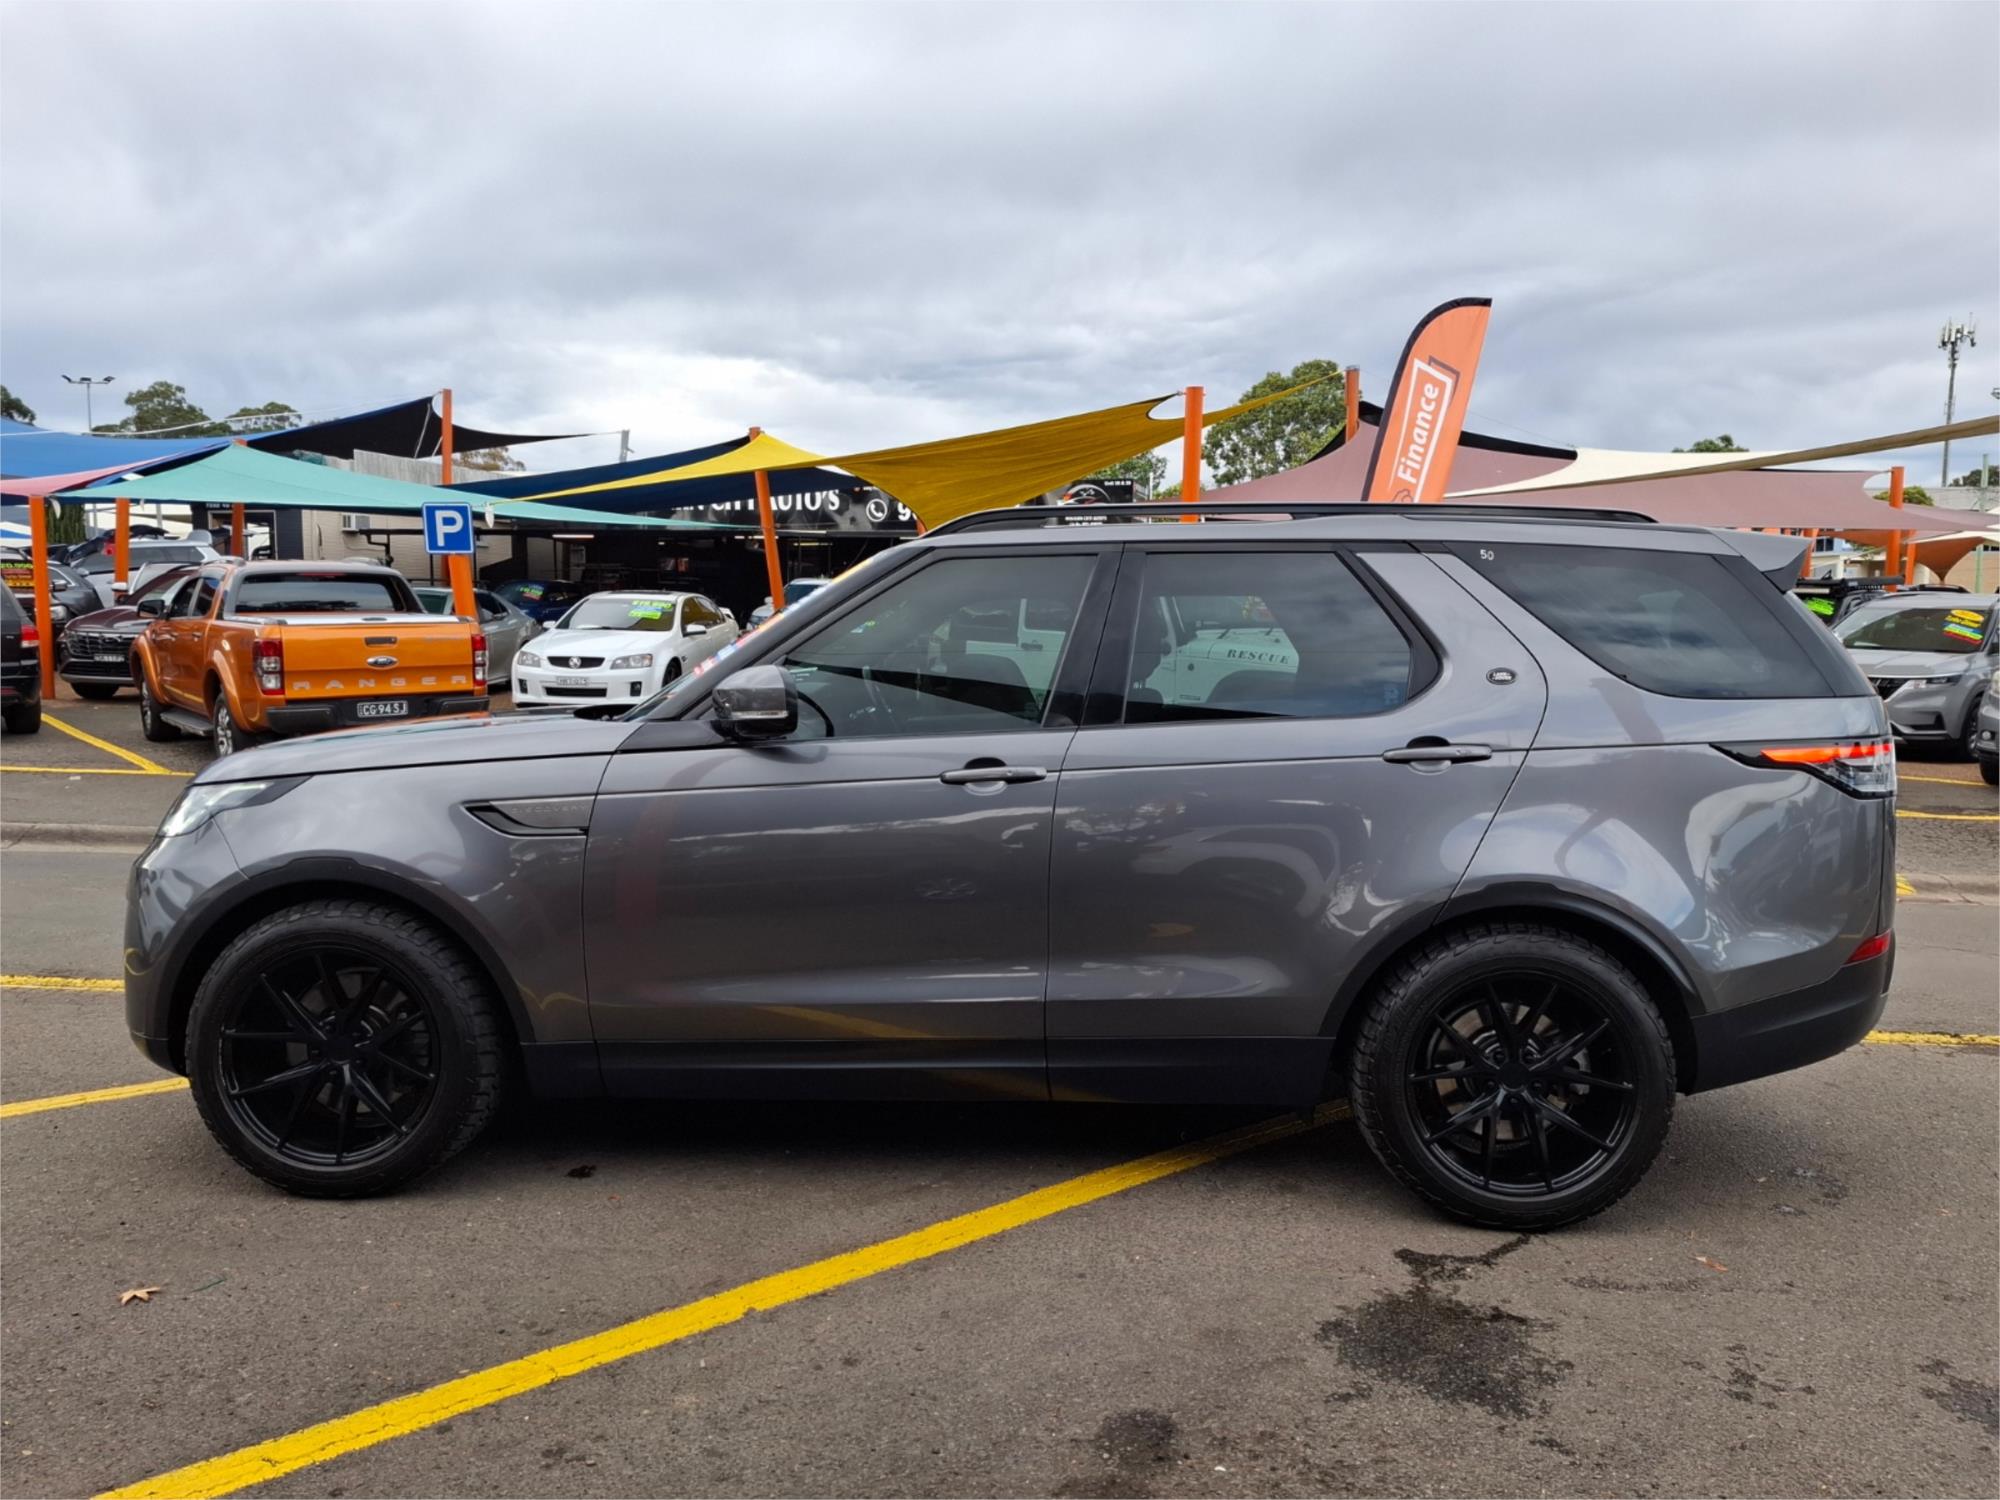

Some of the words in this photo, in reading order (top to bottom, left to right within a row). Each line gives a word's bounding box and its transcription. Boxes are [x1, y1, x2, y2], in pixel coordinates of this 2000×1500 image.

[1397, 382, 1439, 484] Finance
[434, 509, 464, 547] P
[1480, 549, 1494, 560] 50
[1227, 649, 1291, 665] RESCUE
[292, 675, 467, 690] RANGER
